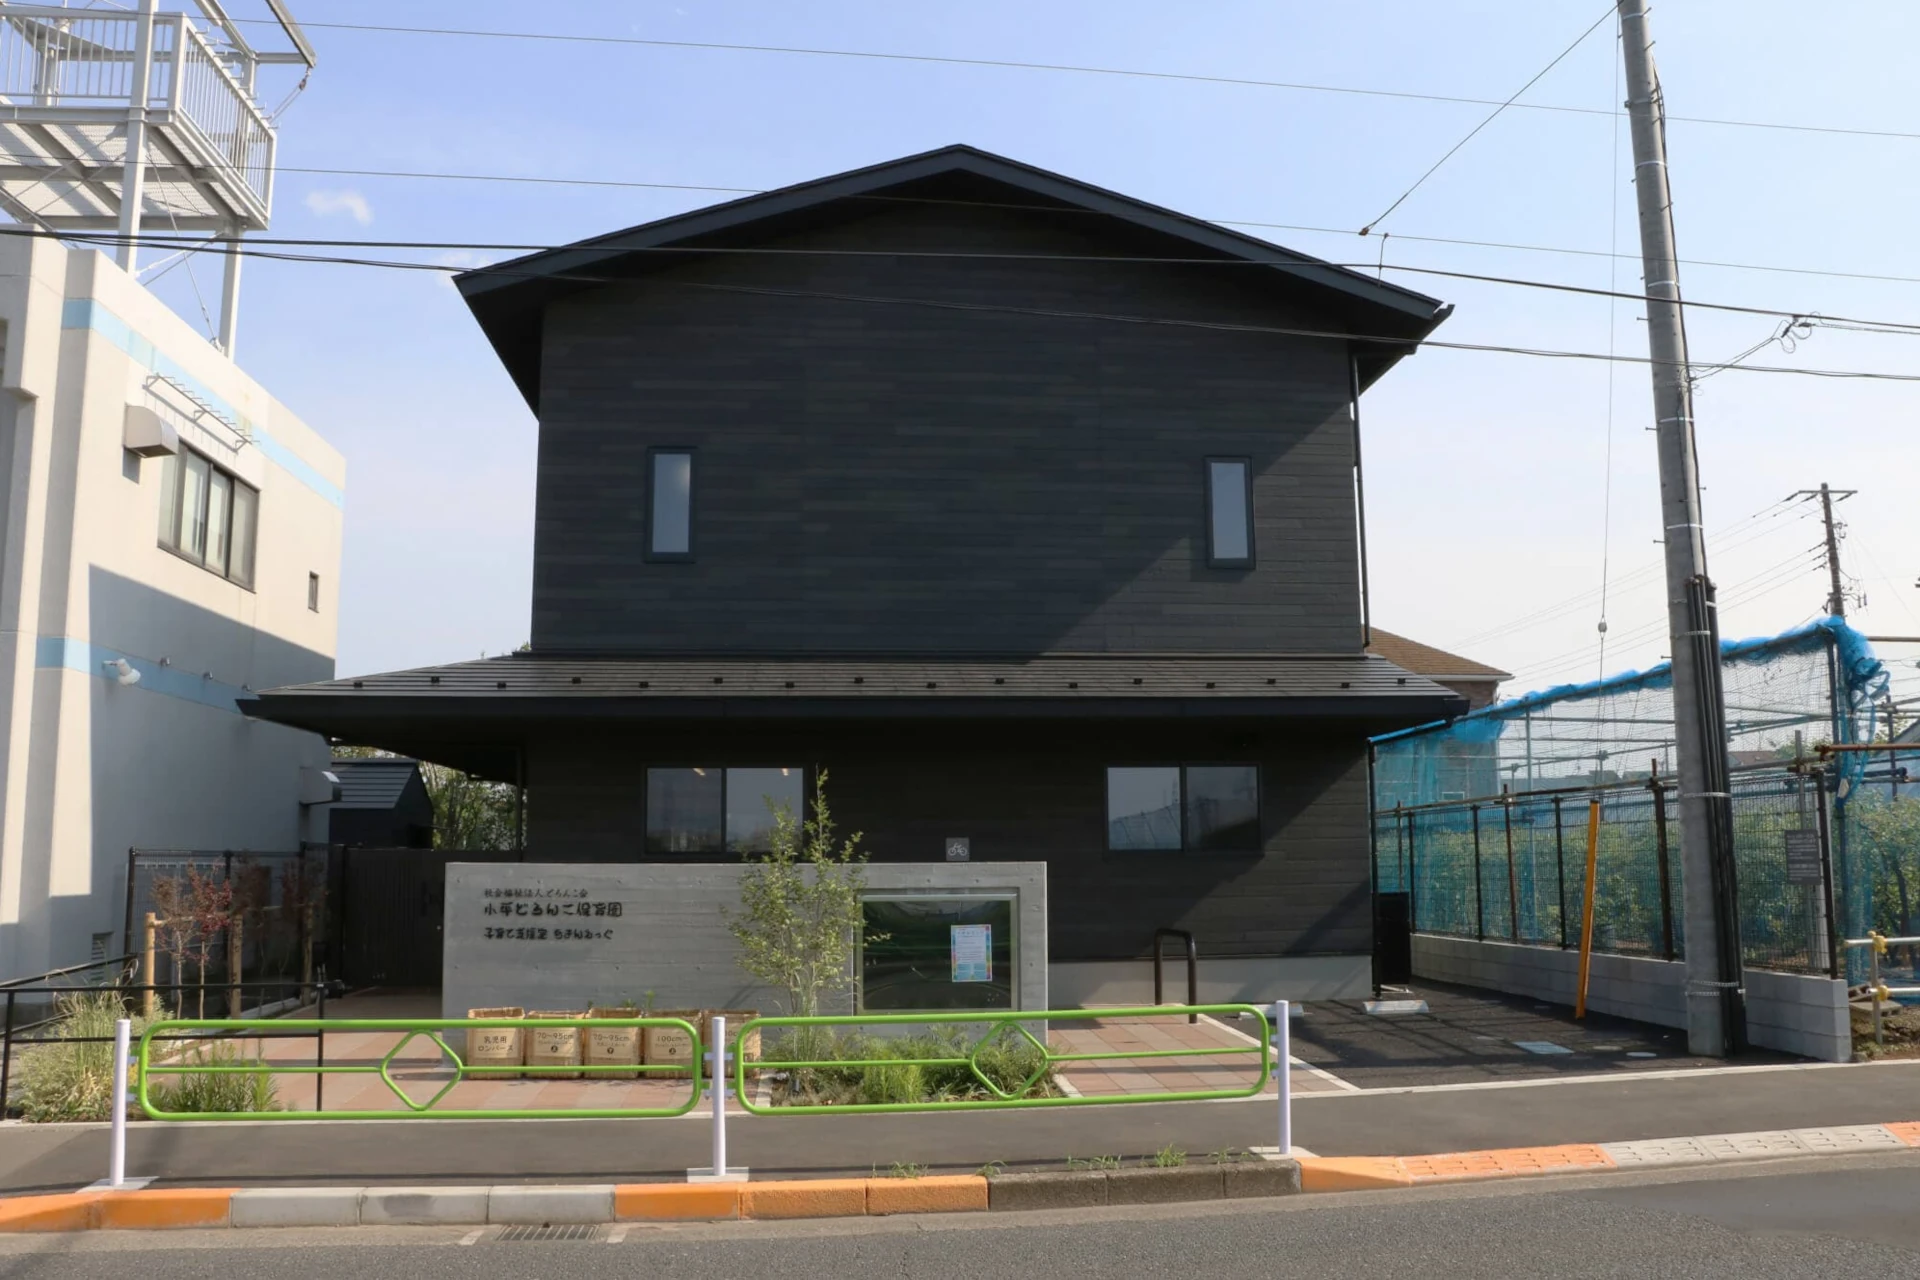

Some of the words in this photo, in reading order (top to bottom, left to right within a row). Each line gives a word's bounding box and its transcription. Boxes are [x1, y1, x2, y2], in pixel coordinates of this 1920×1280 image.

[484, 902, 622, 917] 小平どろんこ保育園
[484, 1035, 507, 1044] 乳児用
